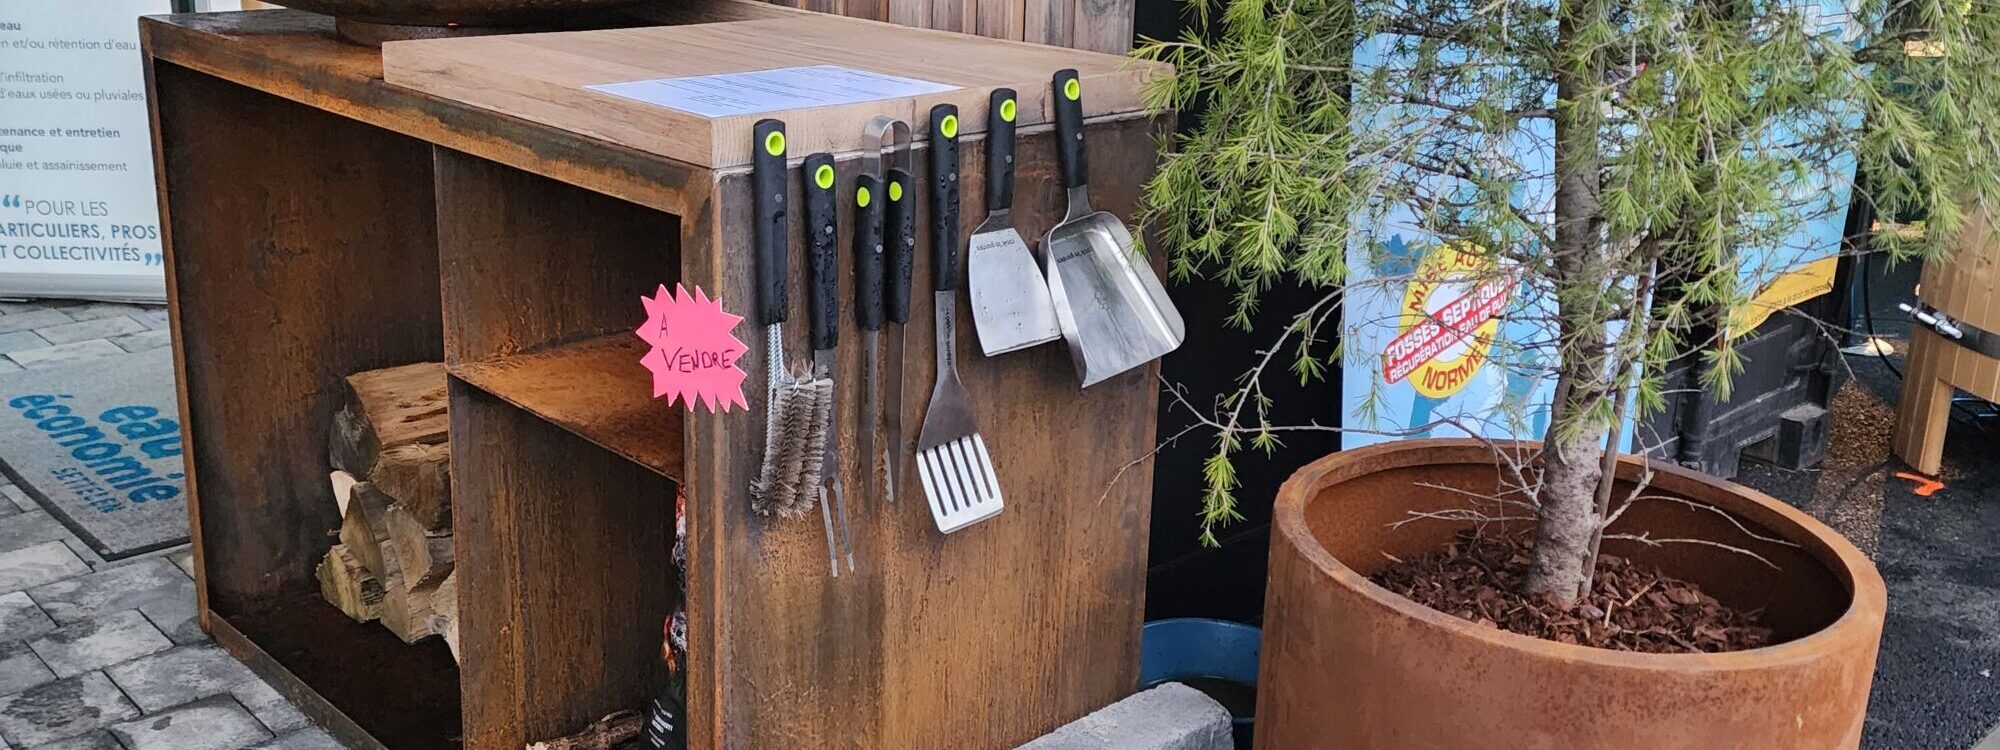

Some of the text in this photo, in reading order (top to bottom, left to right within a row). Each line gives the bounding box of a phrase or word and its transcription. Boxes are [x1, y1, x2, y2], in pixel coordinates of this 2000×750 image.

[13, 39, 44, 50] et/ou
[49, 38, 100, 50] rétention
[104, 38, 136, 51] d'eau
[40, 89, 72, 100] usées
[76, 91, 90, 100] ou
[94, 89, 144, 103] pluviales
[50, 128, 62, 137] et
[66, 127, 120, 138] entretien
[27, 160, 39, 170] et
[42, 160, 128, 172] assainissement
[25, 199, 108, 217] POUR LES
[111, 224, 157, 240] PROS
[13, 242, 141, 262] COLLECTIVITÉS
[659, 312, 668, 338] A
[1386, 321, 1440, 366] FOSSES
[1390, 330, 1459, 383] RÉCUPÉRATION
[1459, 315, 1479, 334] EAU
[1479, 306, 1491, 322] DE
[661, 346, 736, 373] VENDRE
[99, 405, 184, 460] eau
[9, 394, 185, 504] économie
